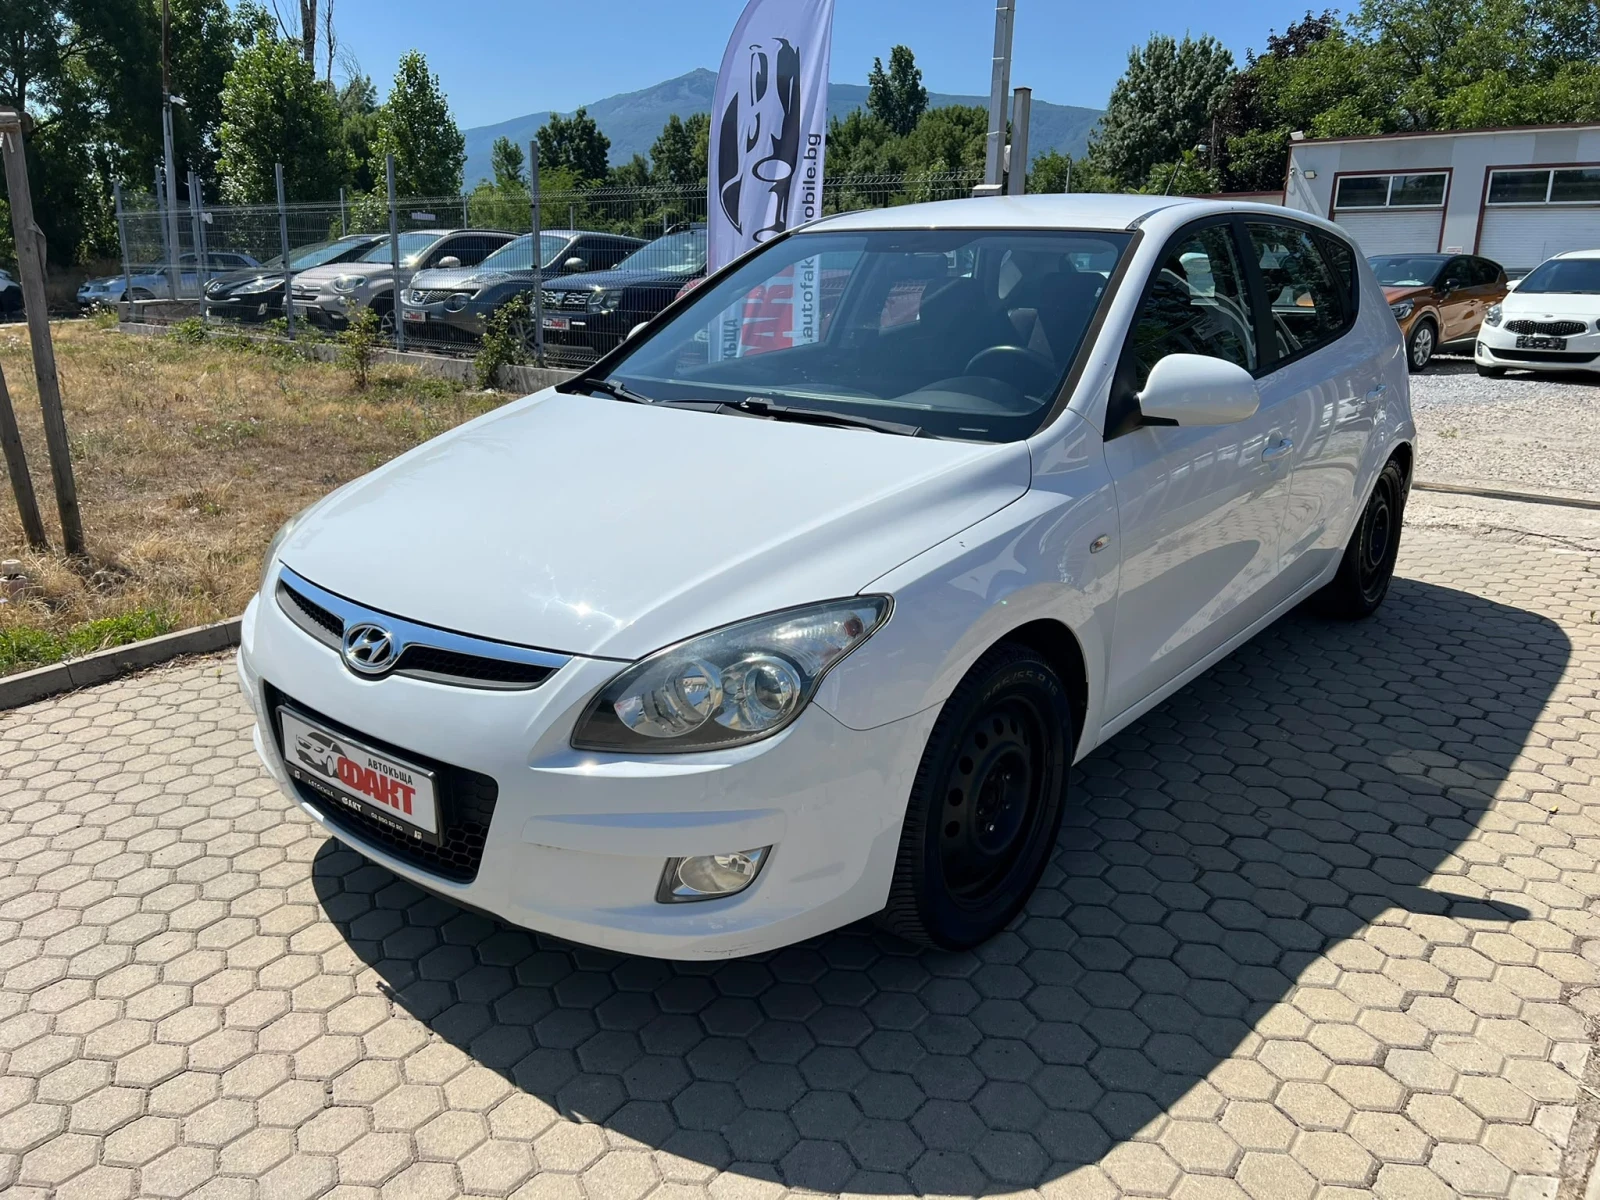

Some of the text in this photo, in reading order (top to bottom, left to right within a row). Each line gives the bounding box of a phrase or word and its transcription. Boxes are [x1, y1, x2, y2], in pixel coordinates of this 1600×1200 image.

[802, 133, 821, 222] obile.bg
[337, 756, 416, 816] ФАКТ
[367, 758, 413, 785] АВТОКЪЩА
